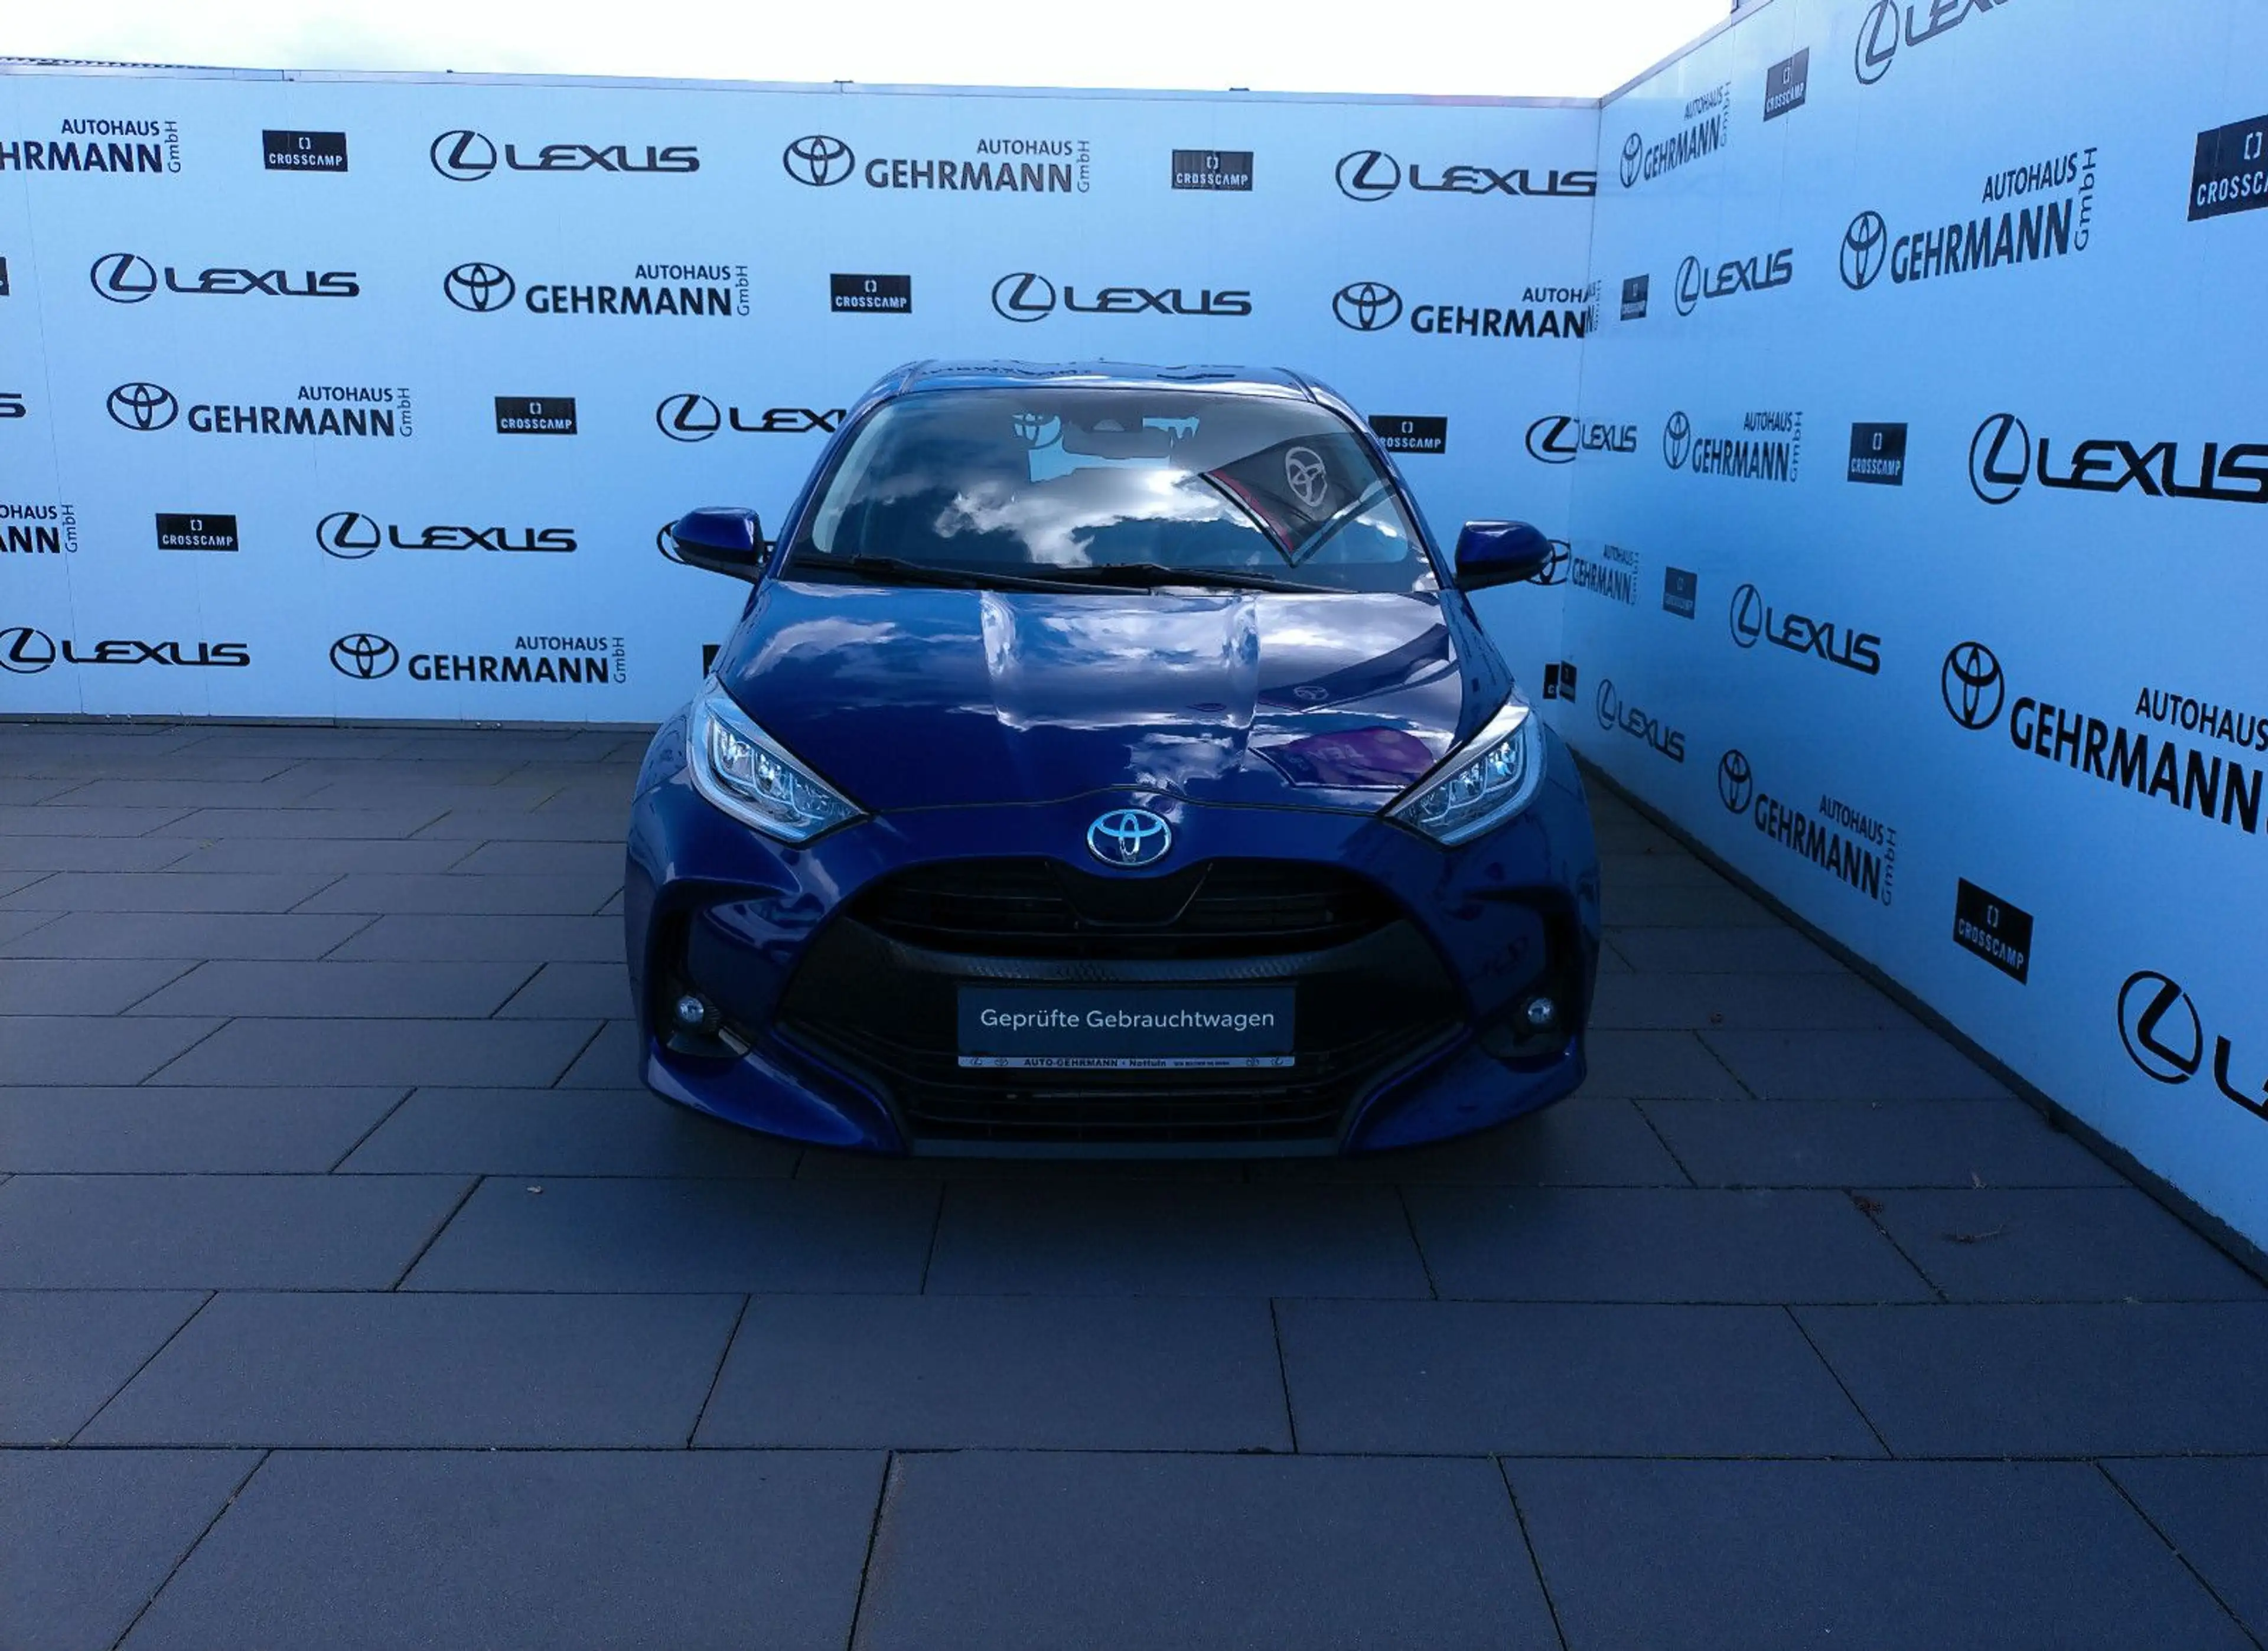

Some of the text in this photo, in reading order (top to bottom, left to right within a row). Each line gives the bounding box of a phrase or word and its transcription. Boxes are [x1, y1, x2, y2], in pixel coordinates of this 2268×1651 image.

[61, 119, 160, 136] AUTOHAUS
[164, 120, 181, 174] GmbH
[269, 153, 343, 166] CROSSCAMP
[504, 144, 700, 173] LEXUS
[977, 139, 1073, 156] AUTOHAUS
[865, 158, 1071, 192] GEHRMANN
[1076, 141, 1090, 194] GmbH
[1176, 172, 1248, 186] CROSSCAMP
[1409, 164, 1598, 197] LEXUS
[1982, 152, 2078, 205] AUTOHAUS
[2074, 147, 2097, 252] GmbH
[1891, 195, 2073, 284] GEHRMANN
[164, 267, 360, 297] LEXUS
[635, 265, 731, 280] AUTOHAUS
[1703, 247, 1793, 299] LEXUS
[526, 285, 732, 316] GEHRMANN
[735, 265, 750, 317] GmbH
[835, 296, 907, 308] CROSSCAMP
[1064, 286, 1252, 317] LEXUS
[298, 386, 393, 403] AUTOHAUS
[188, 404, 395, 437] GEHRMANN
[397, 388, 412, 438] GmbH
[500, 417, 572, 429] CROSSCAMP
[1743, 412, 1793, 433] AUTOHAUS
[1581, 424, 1637, 453] LEXUS
[1692, 438, 1790, 482] GEHRMANN
[2037, 438, 2268, 504] LEXUS
[61, 504, 78, 553] GmbH
[162, 534, 233, 546] CROSSCAMP
[388, 525, 578, 553] LEXUS
[61, 640, 250, 667] LEXUS
[515, 636, 608, 651] AUTOHAUS
[1765, 606, 1881, 676] LEXUS
[408, 654, 609, 684] GEHRMANN
[611, 637, 626, 684] GmbH
[1618, 701, 1686, 764] LEXUS
[2133, 687, 2268, 753] AUTOHAUS
[2010, 694, 2264, 834] GEHRMANN
[1819, 794, 1884, 846] AUTOHAUS
[1754, 794, 1882, 900] GEHRMANN
[1957, 918, 2025, 970] CROSSCAMP
[980, 1009, 1274, 1032] Geprüfte Gebrauchtwagen
